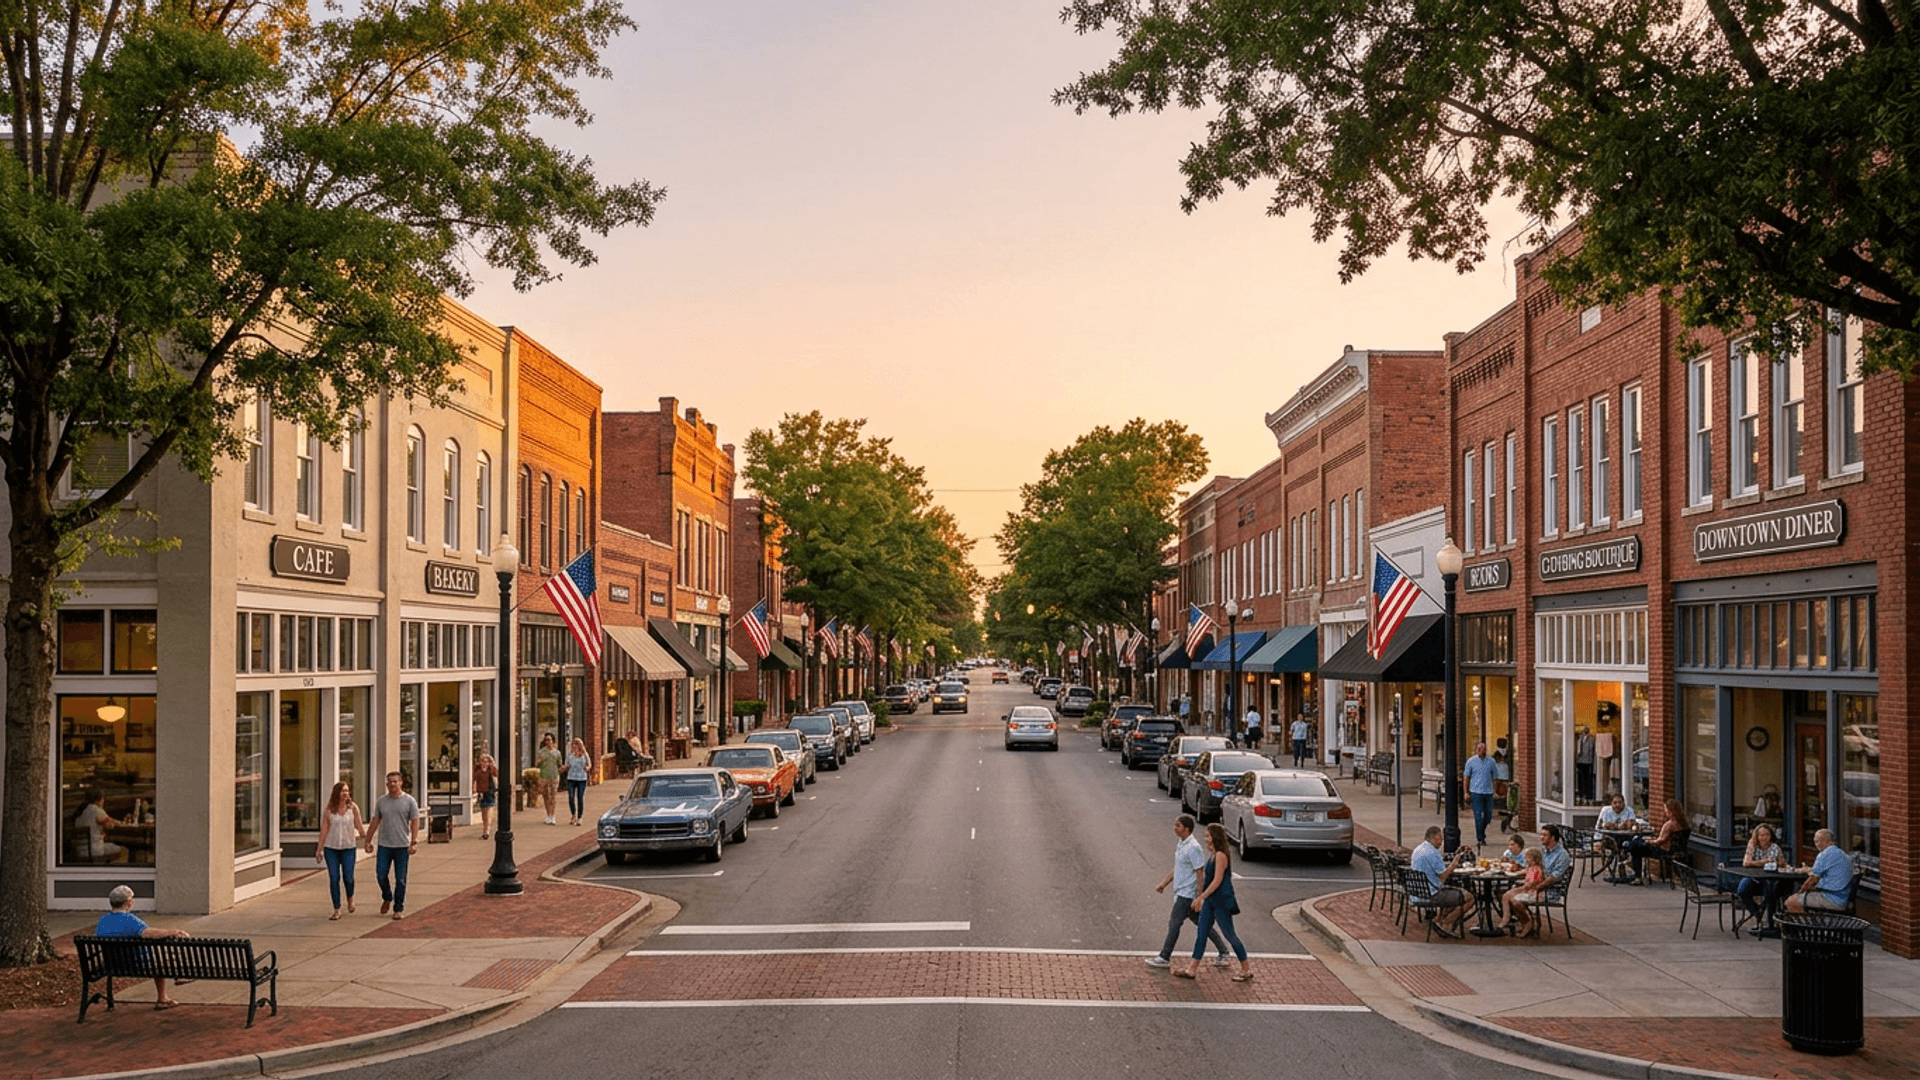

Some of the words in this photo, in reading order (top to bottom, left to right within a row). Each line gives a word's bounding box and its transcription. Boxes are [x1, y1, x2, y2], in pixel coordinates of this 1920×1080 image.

[1699, 519, 1781, 552] DOWNTOWN
[1785, 510, 1835, 540] DINER
[293, 545, 334, 575] CAFE
